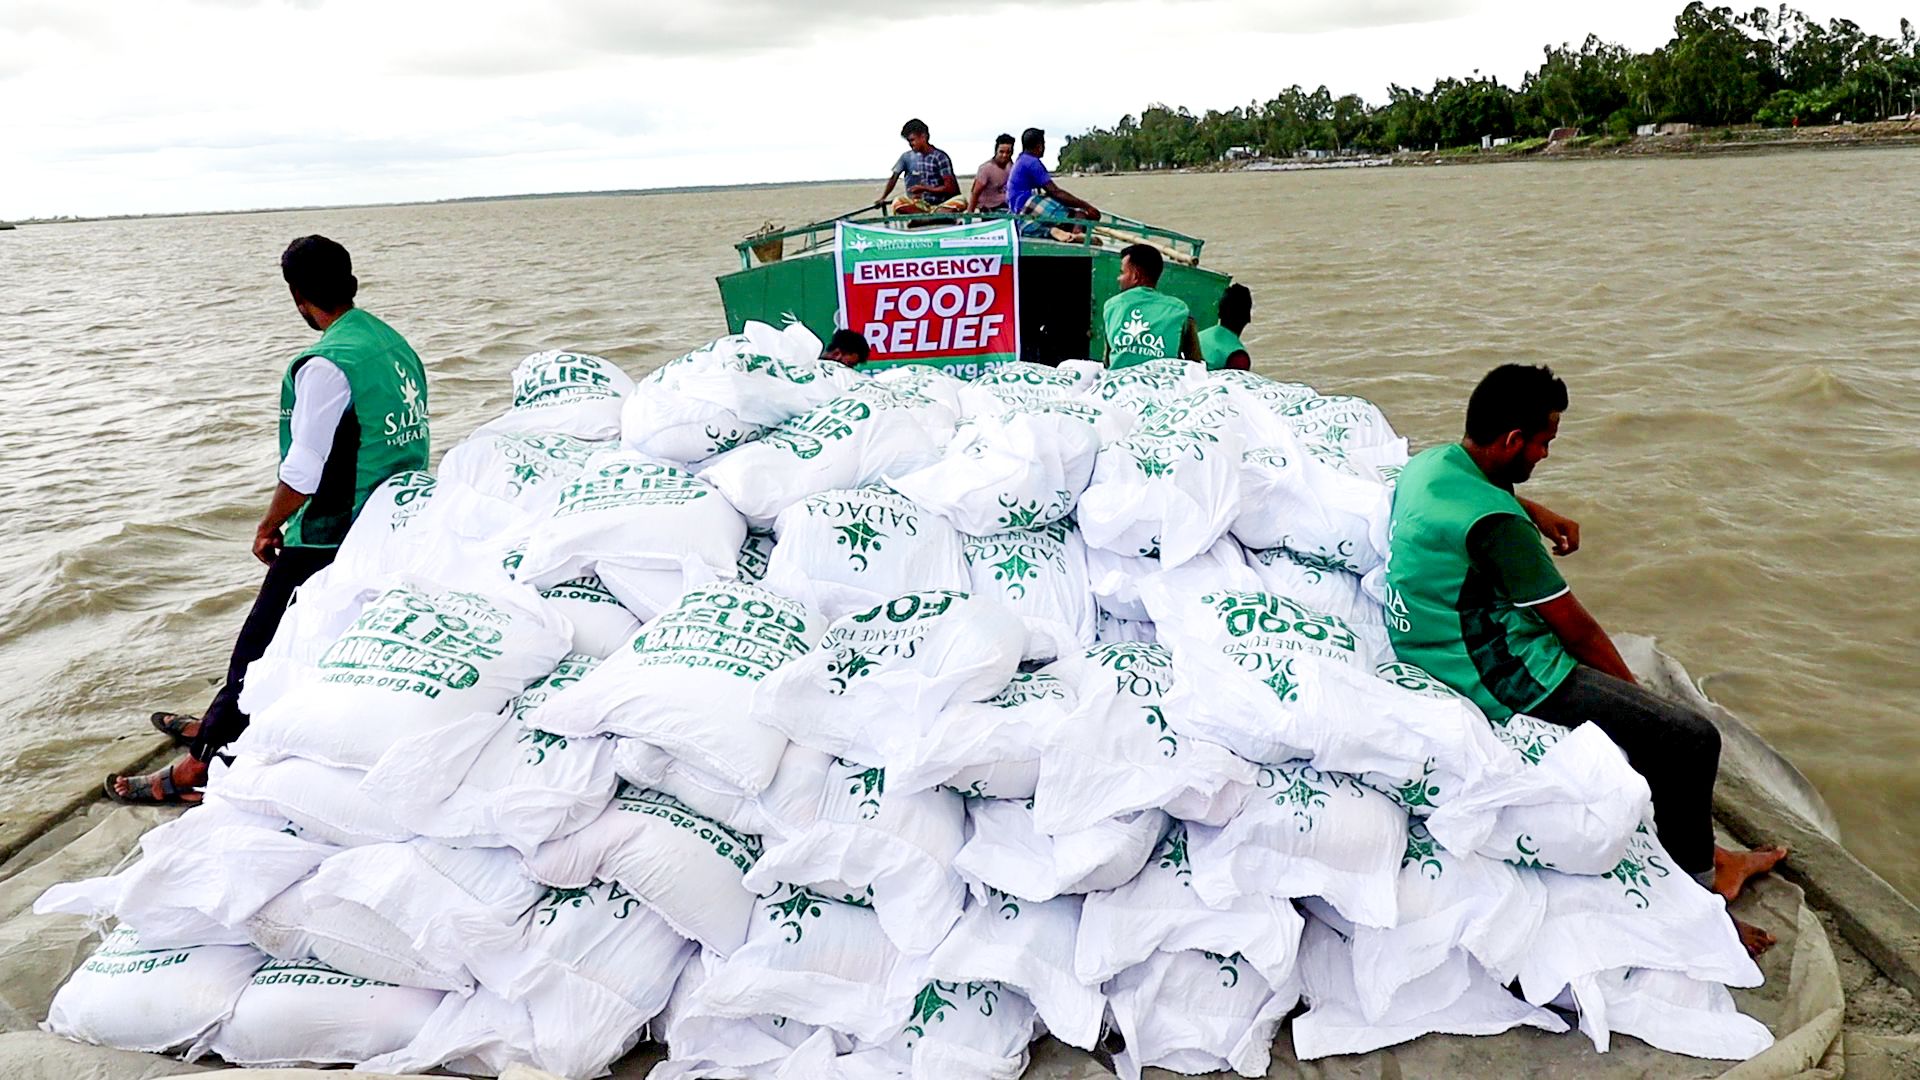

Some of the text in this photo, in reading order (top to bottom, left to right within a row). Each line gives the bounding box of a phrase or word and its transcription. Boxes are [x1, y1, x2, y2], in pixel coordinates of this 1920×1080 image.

[861, 257, 994, 280] EMERGENCY
[874, 283, 995, 320] FOOD
[863, 314, 1004, 354] RELIEF
[1113, 334, 1165, 350] ADAQA
[1138, 346, 1165, 358] FUND
[599, 463, 695, 479] OOD
[806, 499, 918, 538] SADAQA
[964, 544, 1066, 575] SADAQA
[541, 589, 620, 605] qa.org.a
[679, 591, 806, 633] FOOD
[852, 595, 953, 623] FO
[349, 607, 503, 661] RELIEF
[657, 608, 811, 656] RELIEF
[1226, 608, 1356, 653] FOOD
[322, 637, 474, 689] BANGLADESH
[1222, 635, 1349, 664] WELFARE FUND
[638, 652, 766, 682] sadaqa.org.a
[1117, 670, 1170, 698] AQA
[1256, 766, 1364, 798] SADAQ
